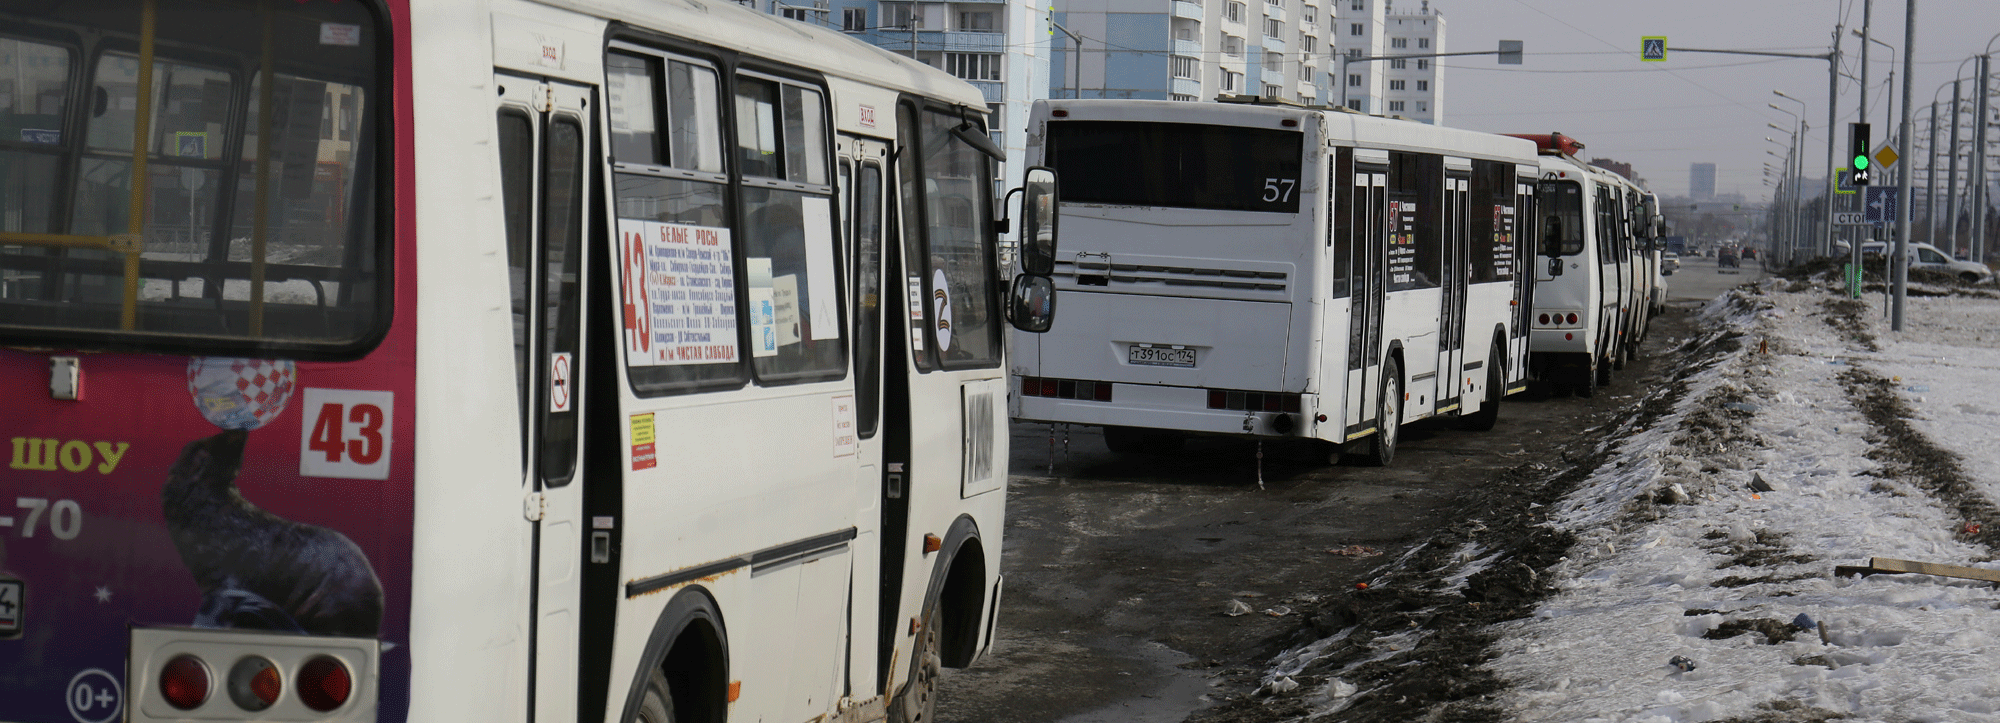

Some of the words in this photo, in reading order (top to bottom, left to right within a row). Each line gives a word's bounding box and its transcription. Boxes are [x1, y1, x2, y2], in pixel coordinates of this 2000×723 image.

[860, 107, 874, 124] ВХОД
[1262, 178, 1296, 203] 57
[660, 226, 688, 244] БЕЛЫЕ
[695, 229, 718, 246] РОСЫ
[622, 231, 650, 353] 43
[677, 346, 702, 360] ЧИСТАЯ
[308, 402, 384, 465] 43
[75, 683, 114, 712] 0+
